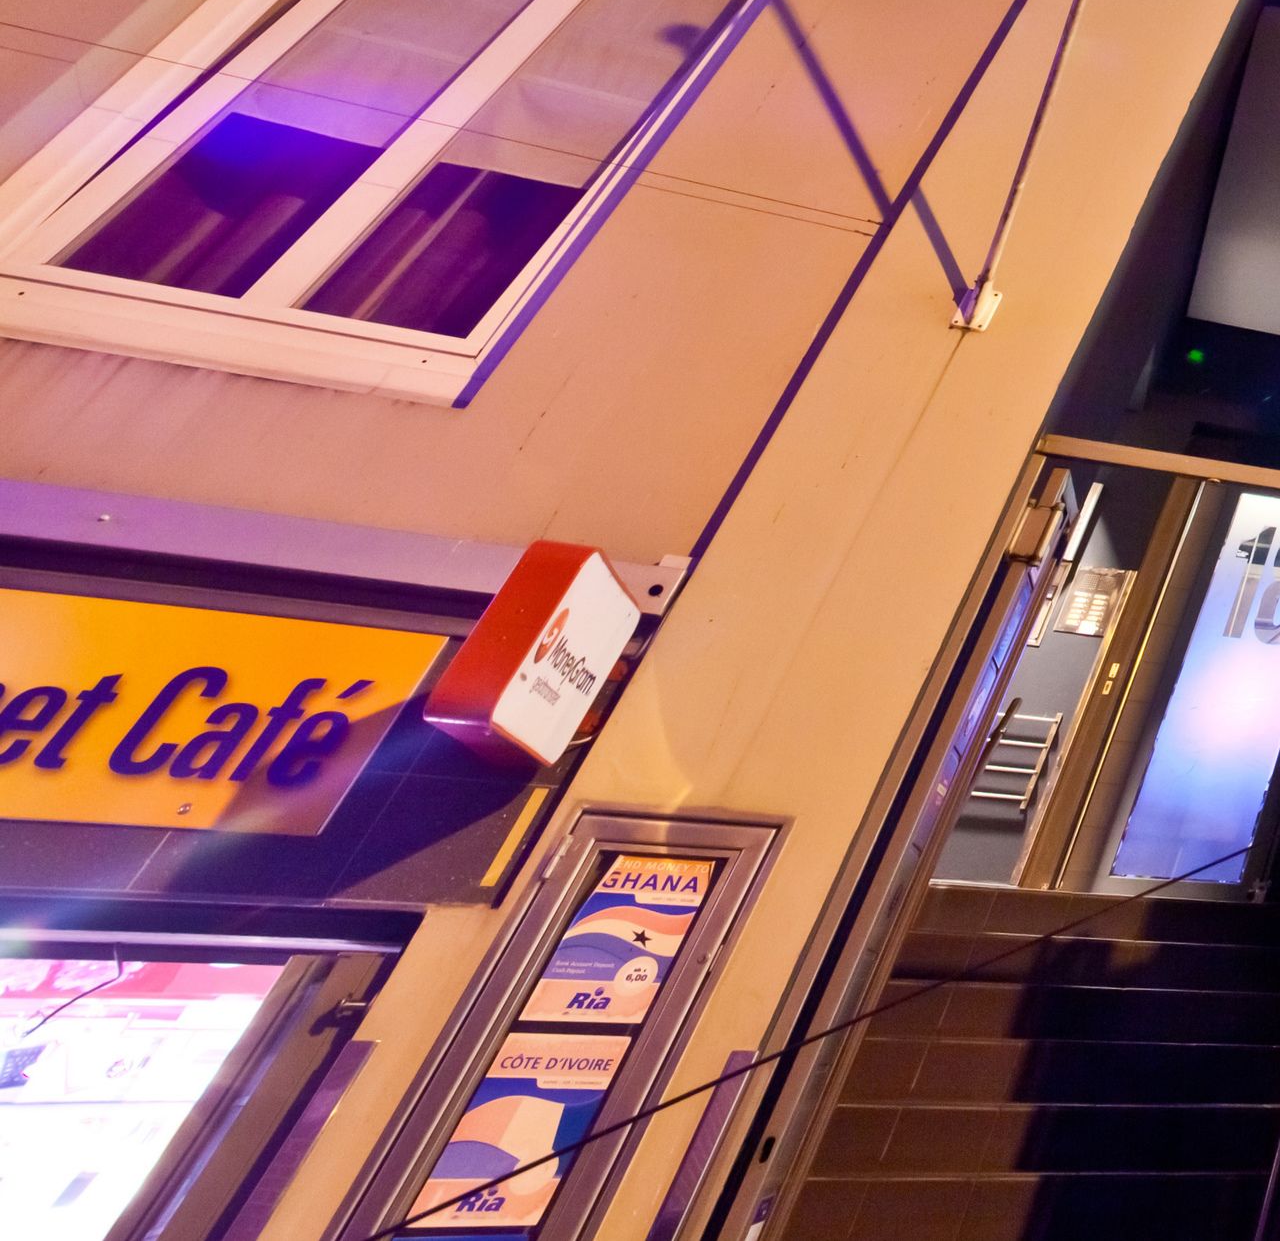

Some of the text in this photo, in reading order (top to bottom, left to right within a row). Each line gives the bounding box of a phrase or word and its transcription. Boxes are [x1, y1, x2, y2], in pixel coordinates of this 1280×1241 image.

[547, 636, 597, 696] MoneyGram
[0, 666, 376, 789] et Café
[602, 871, 698, 893] GHANA
[625, 974, 648, 982] 6,00
[567, 987, 612, 1010] Ria
[500, 1054, 614, 1071] CÔTE D'IVOIRE
[455, 1184, 506, 1213] Ria
